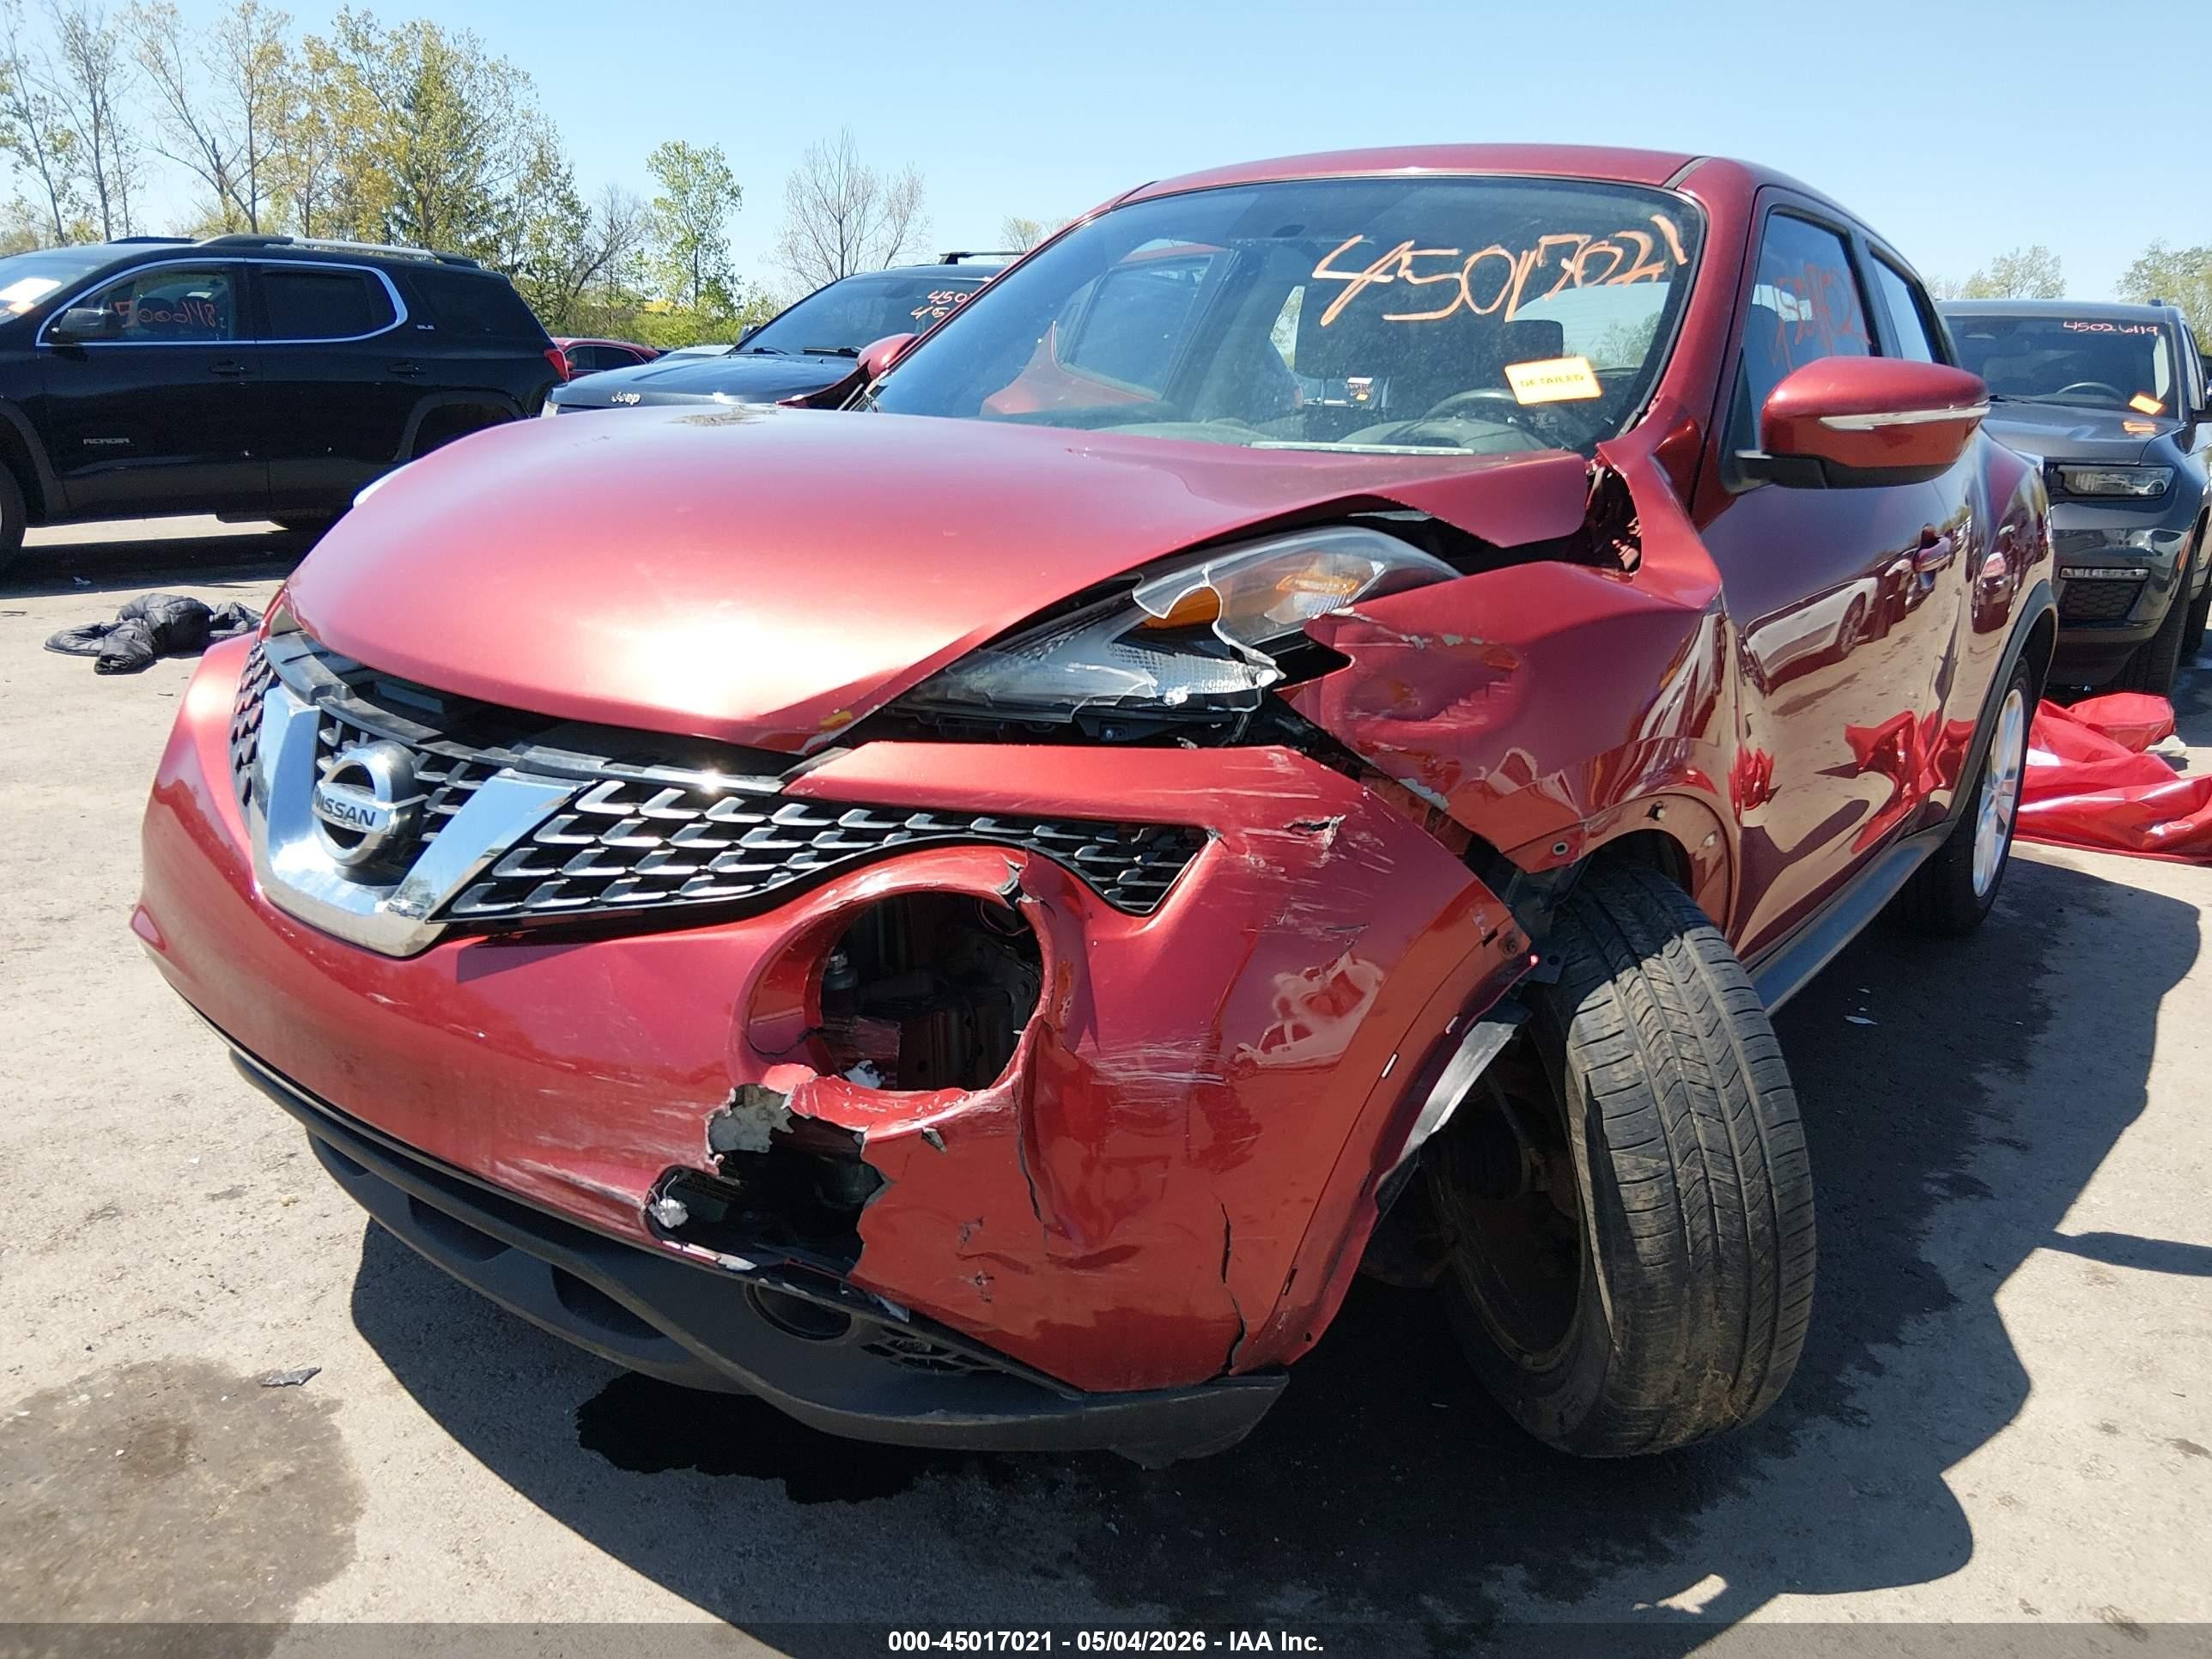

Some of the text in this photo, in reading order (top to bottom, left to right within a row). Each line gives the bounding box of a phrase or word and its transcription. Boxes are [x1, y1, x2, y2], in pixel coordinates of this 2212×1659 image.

[1312, 215, 1688, 326] 45017021
[611, 392, 641, 405] Jeep
[314, 787, 376, 827] NISSAN
